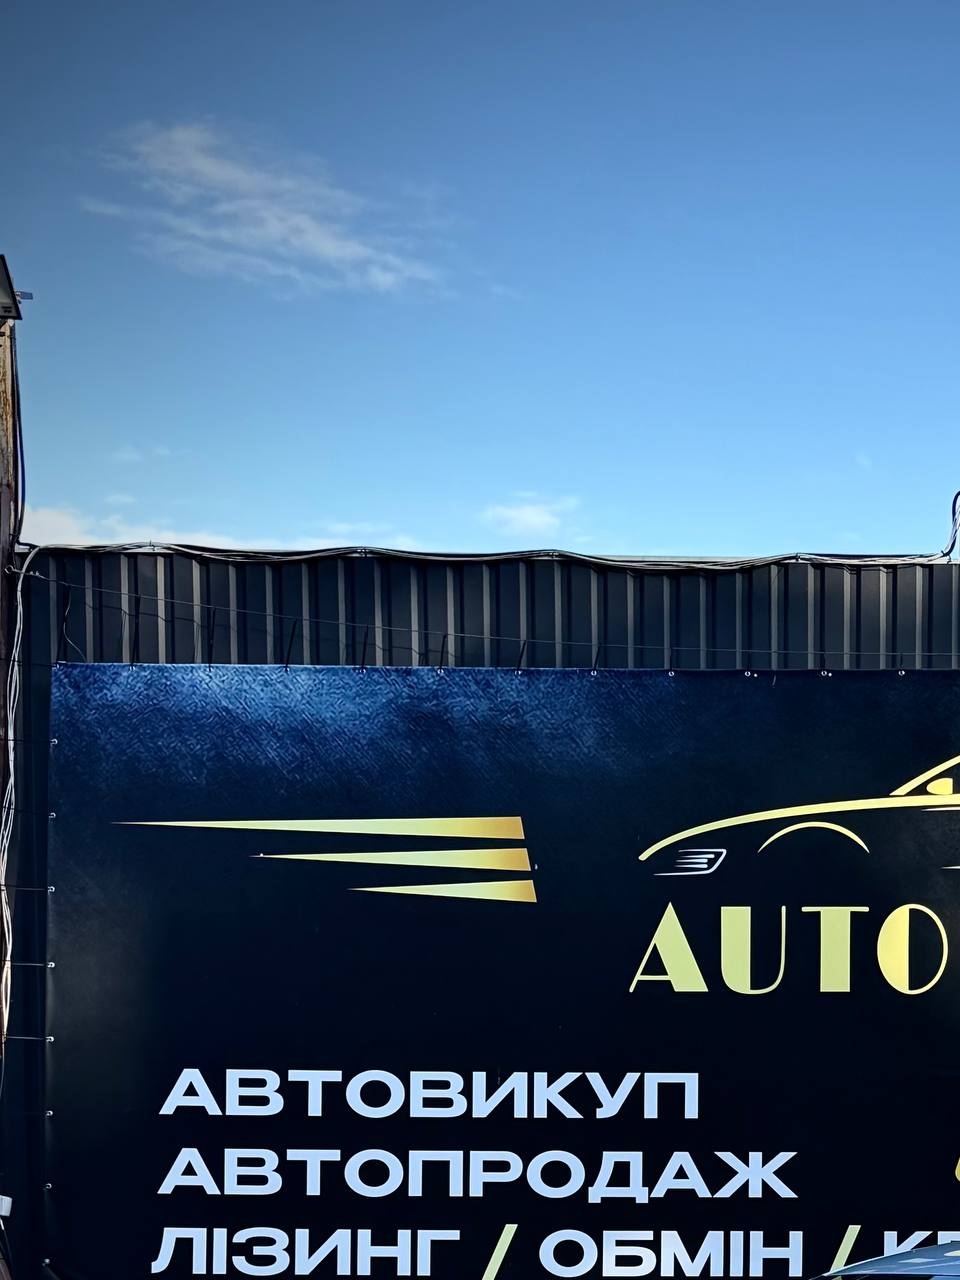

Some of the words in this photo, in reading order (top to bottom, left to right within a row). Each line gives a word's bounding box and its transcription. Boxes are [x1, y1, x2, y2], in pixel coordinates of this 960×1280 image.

[159, 1069, 699, 1119] АВТОВИКУП
[157, 1148, 798, 1203] АВТОПРОДАЖ
[151, 1227, 460, 1276] ЛІЗИНГ
[538, 1229, 803, 1277] ОБМІН
